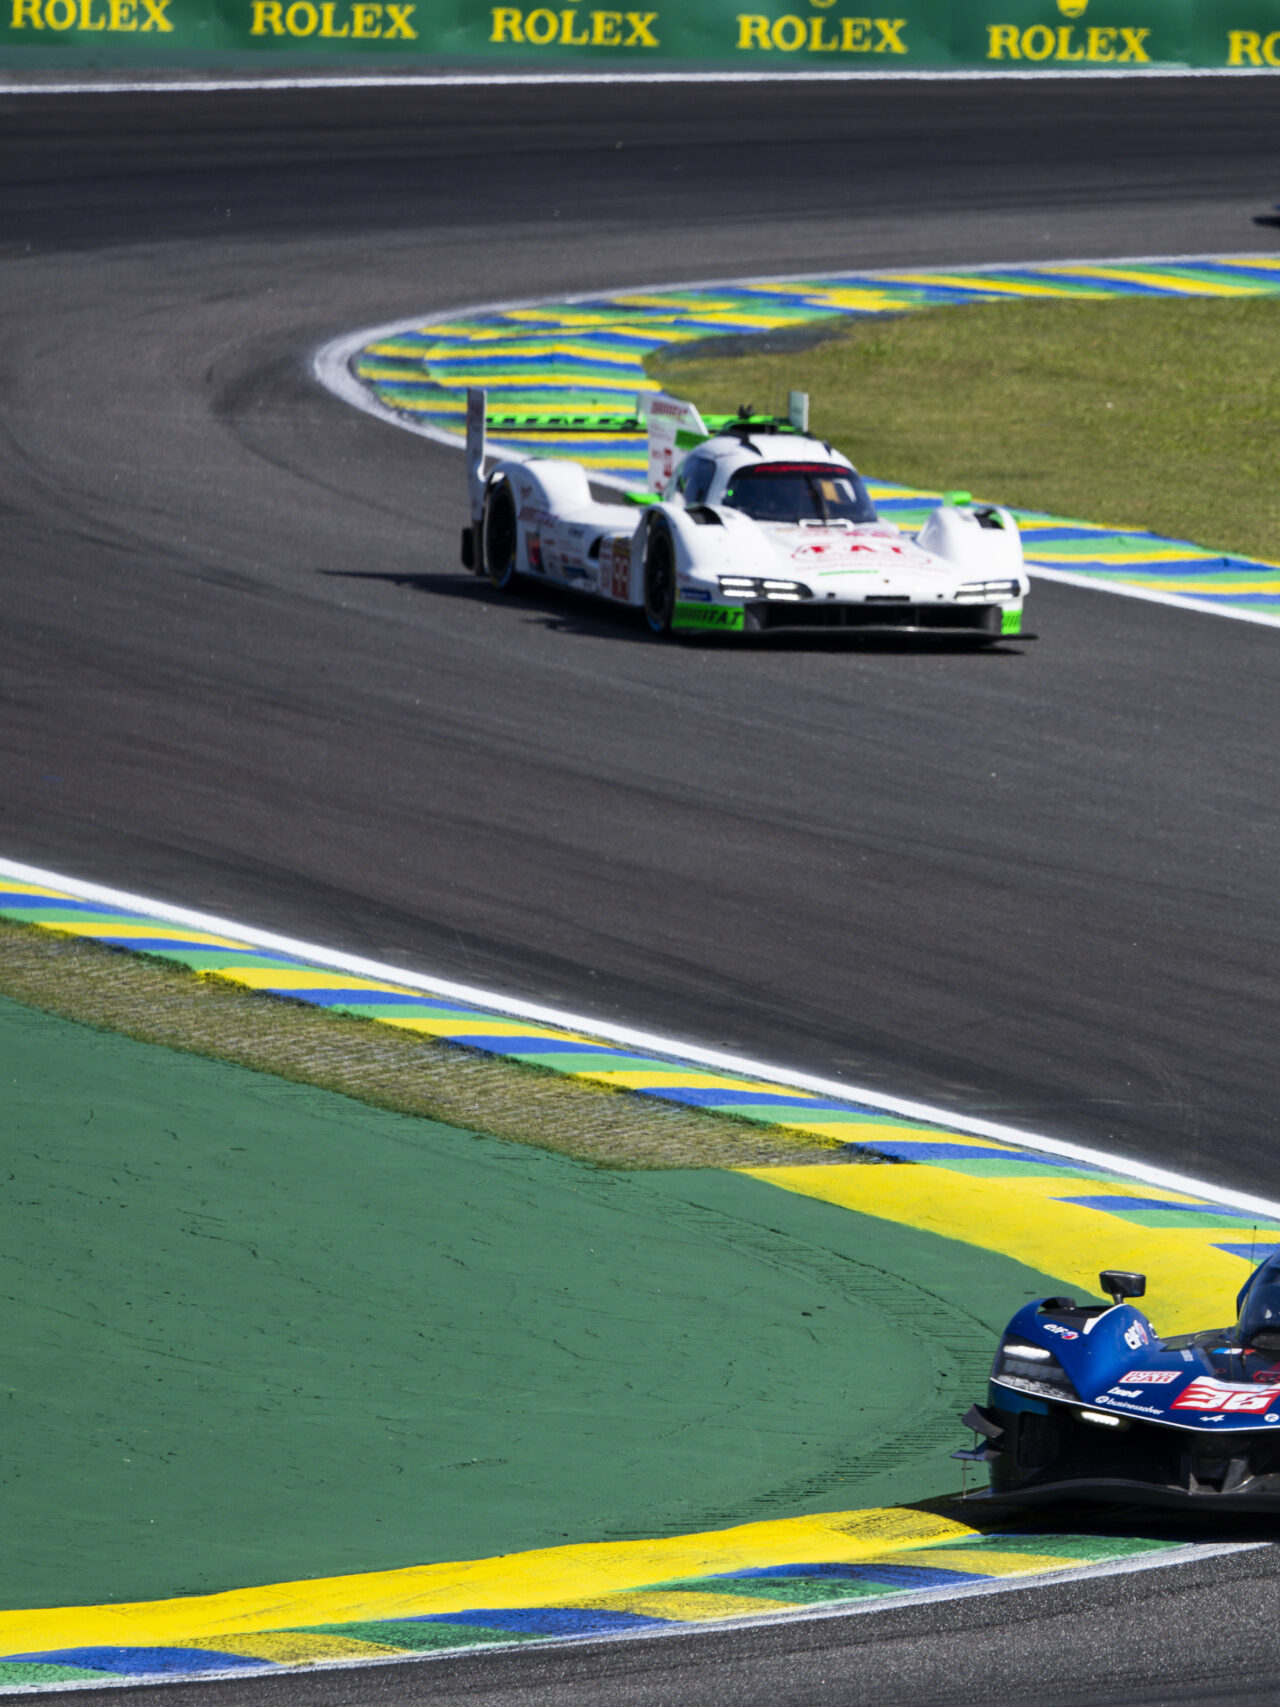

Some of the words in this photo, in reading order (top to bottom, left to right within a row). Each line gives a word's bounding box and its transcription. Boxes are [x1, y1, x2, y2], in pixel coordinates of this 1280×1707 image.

[10, 0, 174, 32] ROLEX
[250, 1, 418, 39] ROLEX
[490, 7, 660, 47] ROLEX
[737, 14, 909, 54] ROLEX
[986, 24, 1151, 63] ROLEX
[1043, 1323, 1067, 1336] elf
[1105, 1396, 1165, 1416] businessolver
[1175, 1385, 1279, 1411] 36
